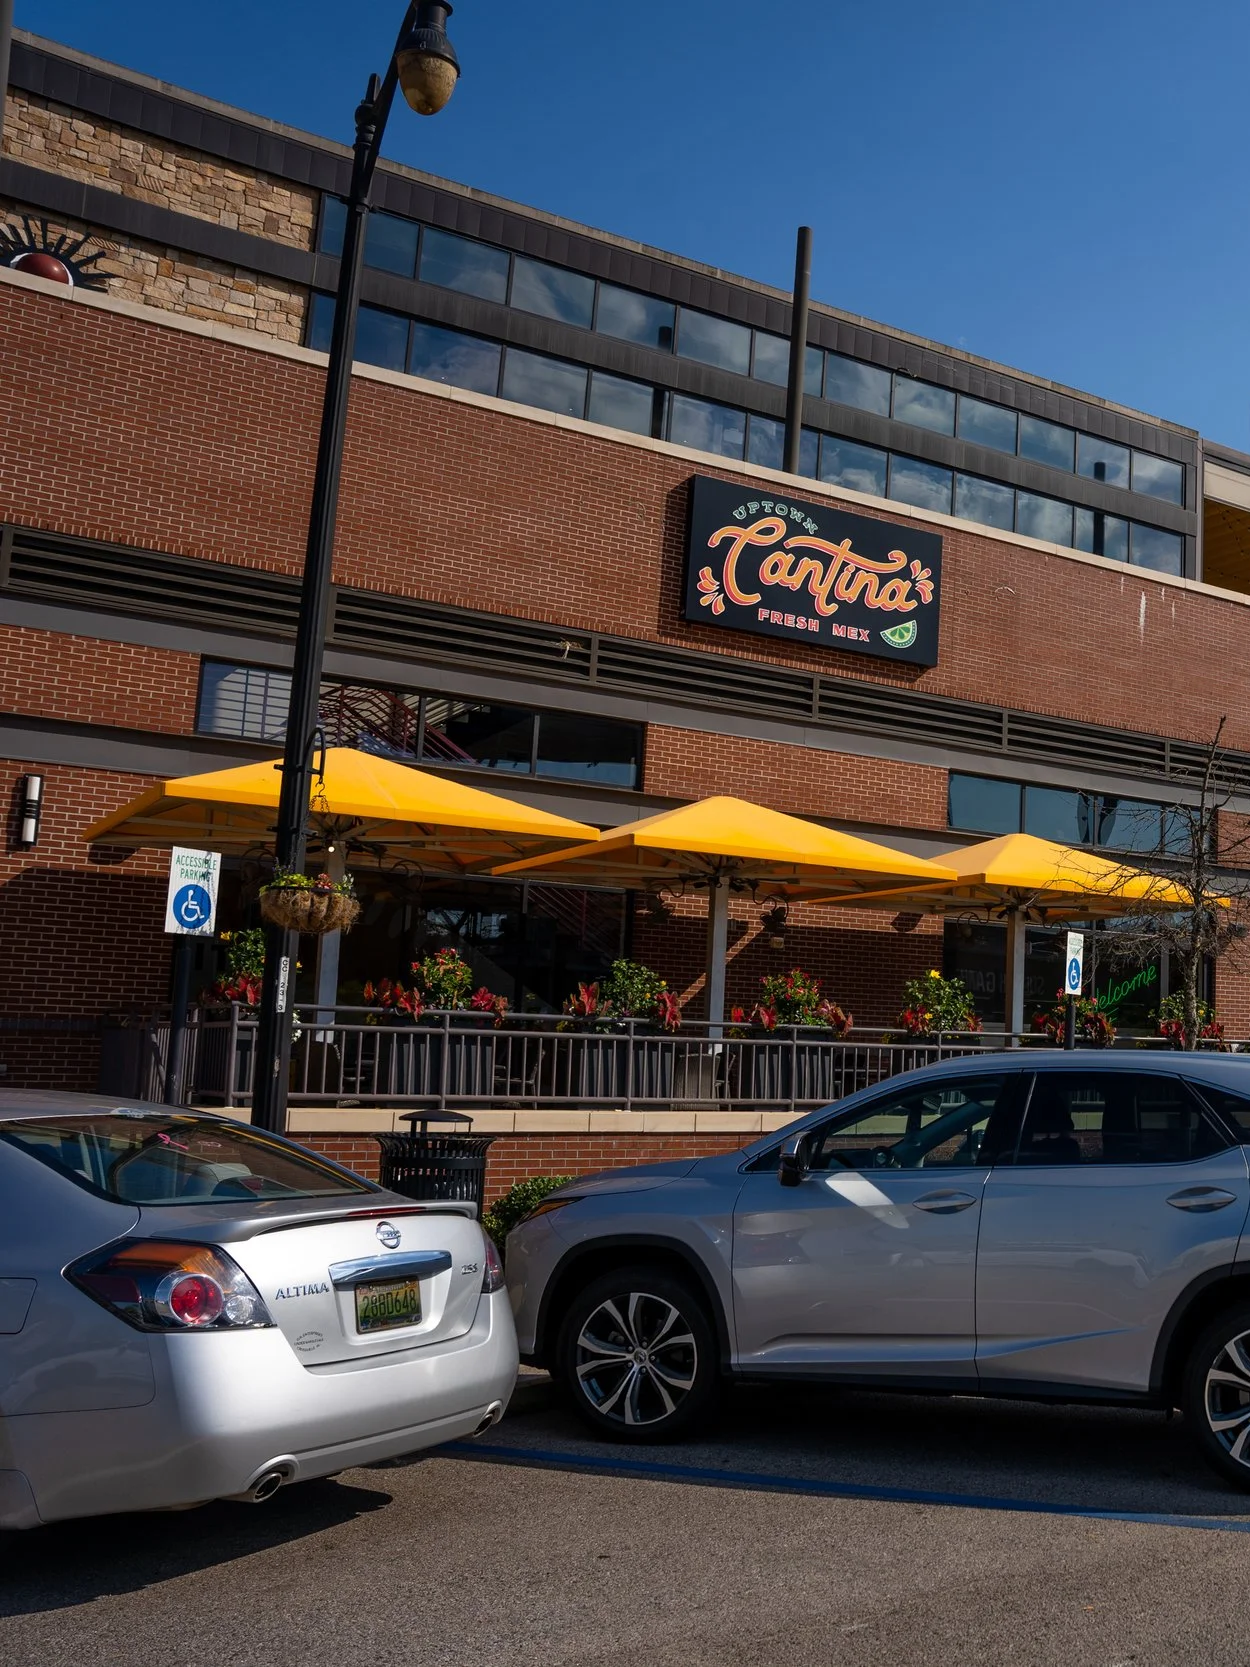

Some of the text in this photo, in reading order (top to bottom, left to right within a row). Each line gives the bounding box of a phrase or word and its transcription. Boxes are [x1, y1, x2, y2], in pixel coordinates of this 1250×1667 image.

[732, 500, 818, 535] UPTOWN
[707, 516, 918, 617] Cantina
[758, 608, 870, 643] FRESH MEX
[175, 855, 217, 871] ACCESSIBLE
[180, 868, 212, 882] PARKING
[275, 1283, 330, 1301] ALTIMA
[362, 1289, 417, 1321] 28BD648
